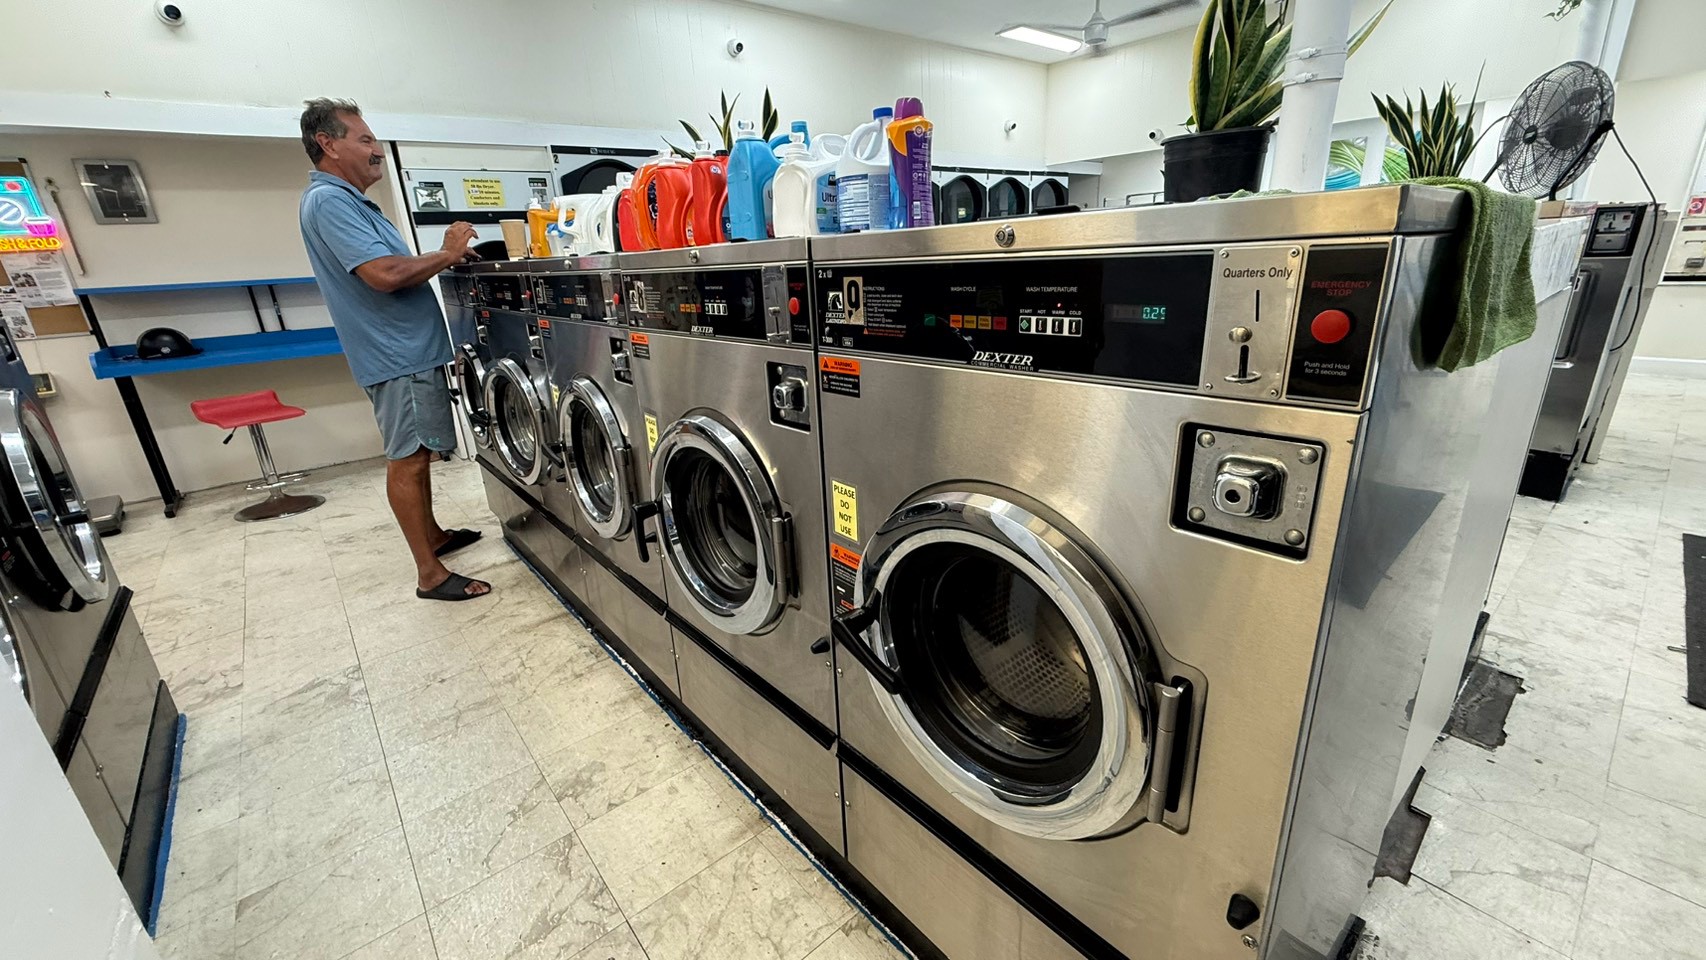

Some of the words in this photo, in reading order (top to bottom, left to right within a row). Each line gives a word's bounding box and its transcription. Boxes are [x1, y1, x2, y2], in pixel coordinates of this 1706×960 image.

[553, 154, 559, 164] 2
[1222, 268, 1266, 278] Quarters
[1268, 266, 1293, 280] Only
[1311, 280, 1372, 289] EMERGENCY
[1326, 288, 1352, 296] STOP
[691, 325, 714, 333] DEXTER
[972, 350, 1034, 366] DEXTER
[970, 360, 1006, 370] COMMERCIAL
[1009, 364, 1034, 372] WASHER
[834, 484, 856, 500] PLEASE
[840, 500, 850, 510] DO
[839, 511, 852, 524] NOT
[840, 524, 852, 536] USE
